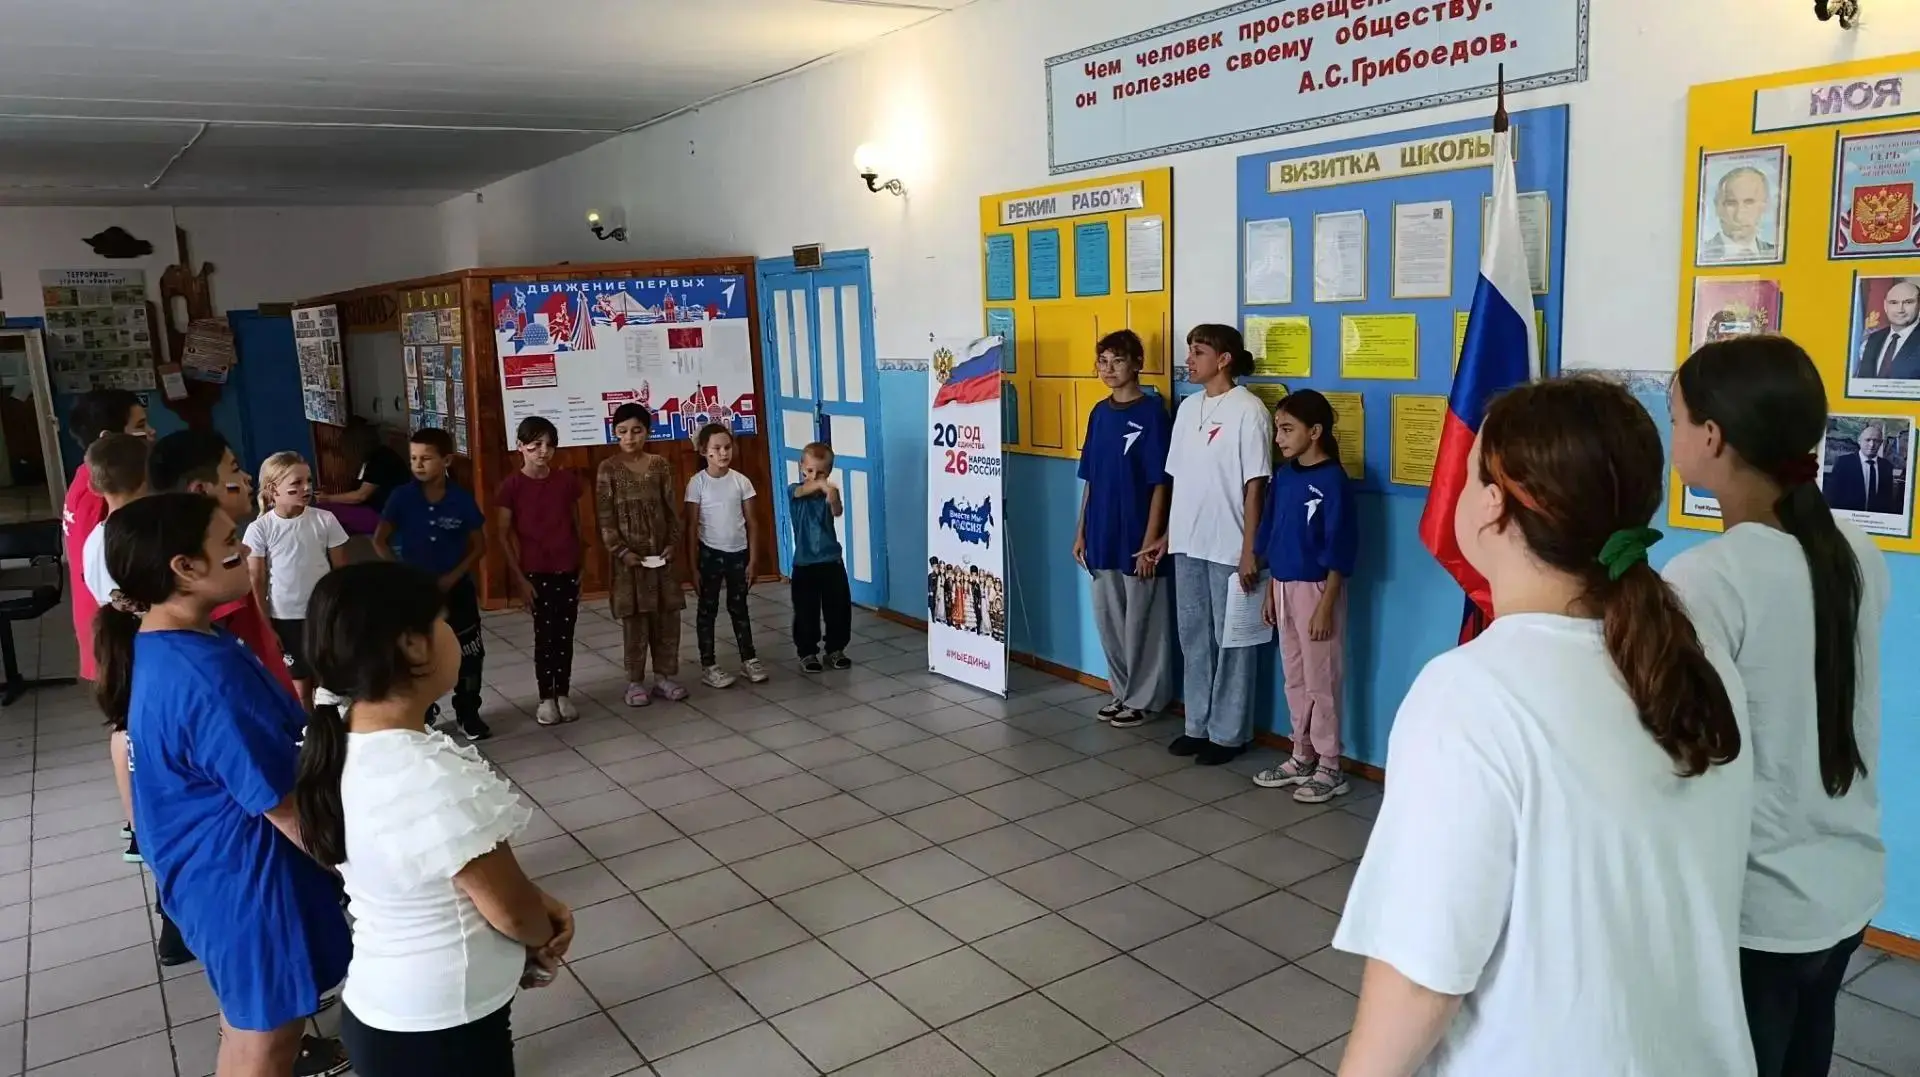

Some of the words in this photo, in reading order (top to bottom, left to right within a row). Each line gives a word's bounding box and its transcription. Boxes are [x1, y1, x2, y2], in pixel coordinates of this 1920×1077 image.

[1075, 91, 1097, 108] он
[1112, 63, 1211, 100] полезнее
[1226, 37, 1314, 72] своему
[1335, 0, 1493, 46] обществу.
[1084, 58, 1122, 80] Чем
[1136, 31, 1223, 68] человек
[1298, 32, 1518, 94] А.С.Грибоедов.
[1810, 77, 1902, 116] МОЯ
[1280, 151, 1381, 185] ВИЗИТКА
[1008, 197, 1057, 220] РЕЖИМ
[526, 281, 626, 295] ДВИЖЕНИЕ
[635, 279, 705, 290] ПЕРВЫХ
[933, 422, 958, 449] 20
[957, 425, 981, 442] ГОД
[957, 441, 985, 450] ЕДИНСТВА
[945, 449, 968, 476] 26
[968, 455, 1001, 467] НАРОДОВ
[968, 464, 1001, 477] РОССИИ
[949, 509, 970, 521] Вместе
[951, 518, 983, 534] РОССИЯ
[945, 649, 991, 671] #МЫЕДИНЫ
